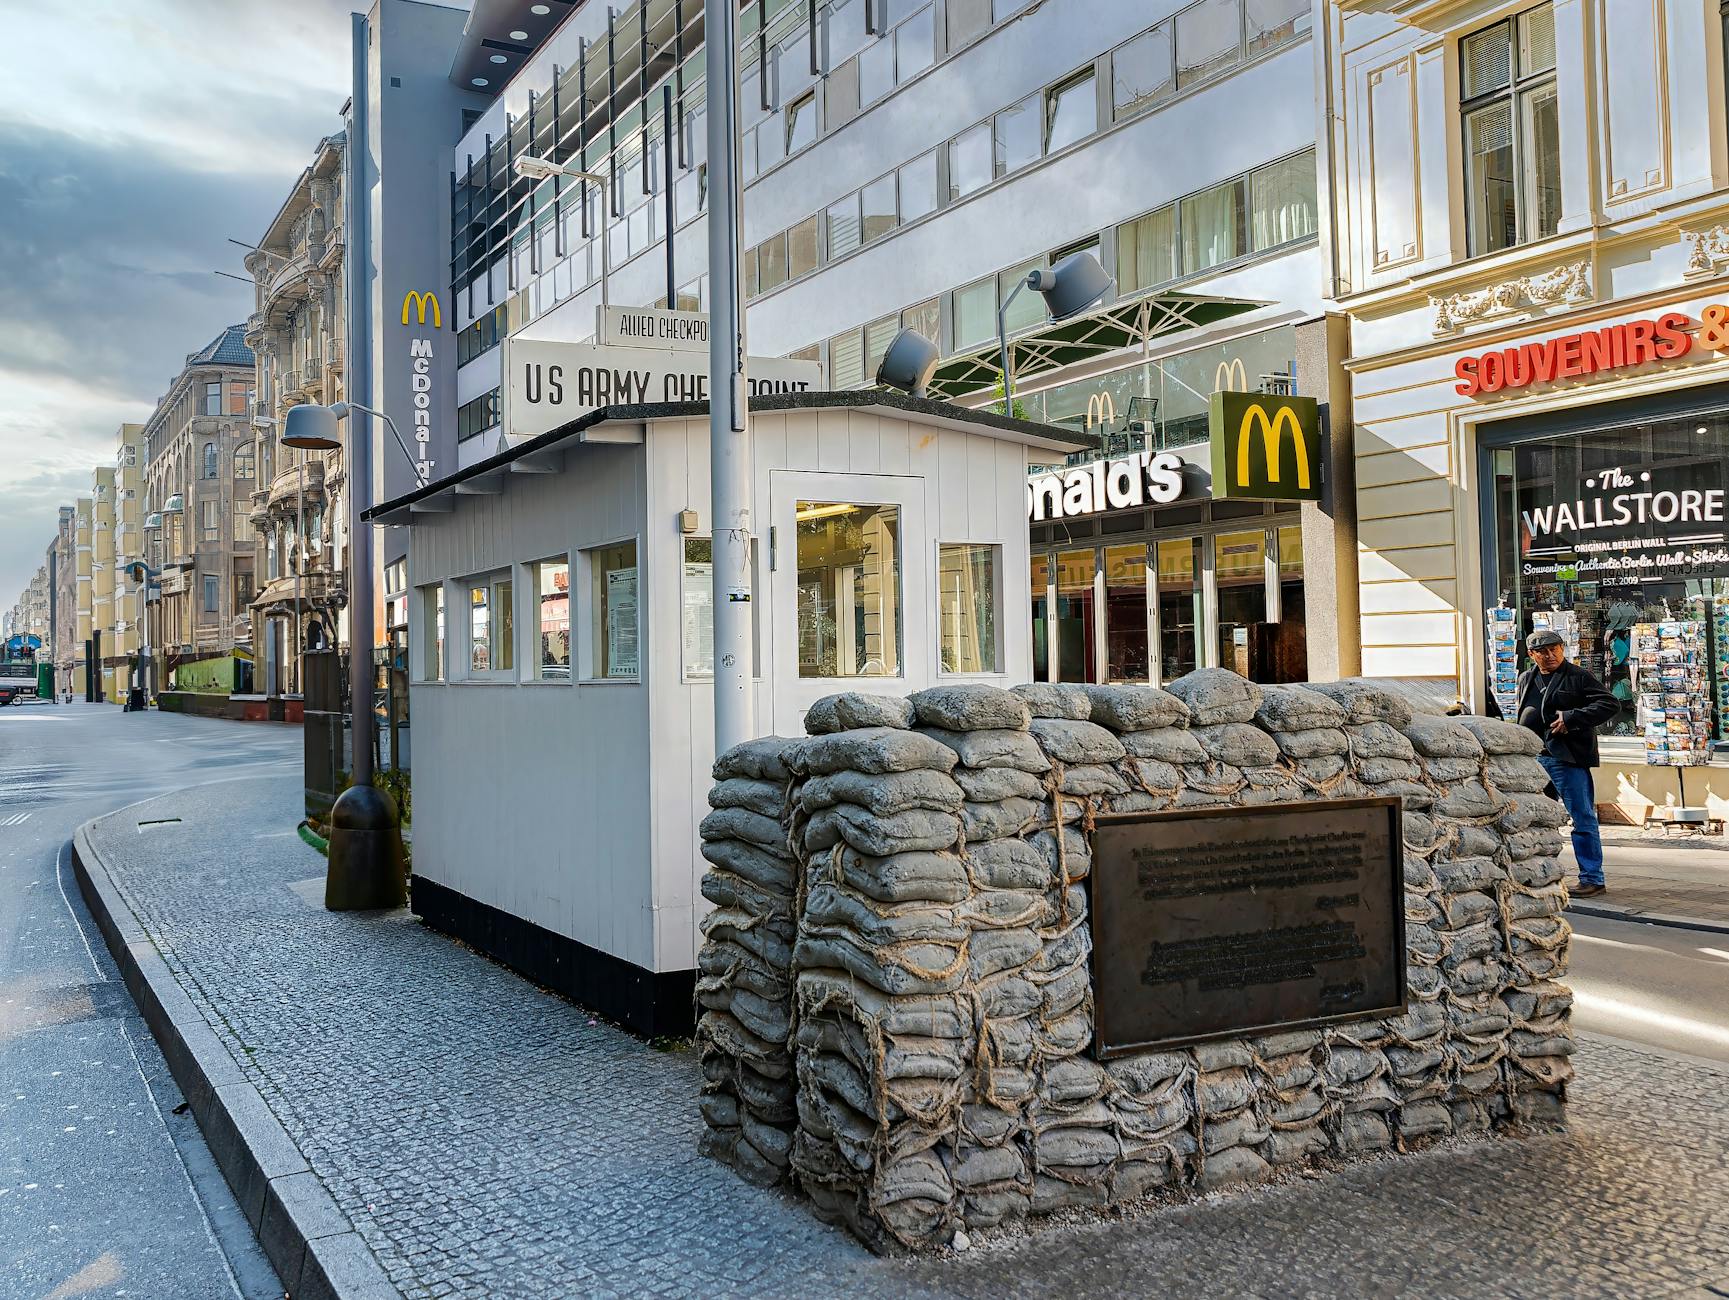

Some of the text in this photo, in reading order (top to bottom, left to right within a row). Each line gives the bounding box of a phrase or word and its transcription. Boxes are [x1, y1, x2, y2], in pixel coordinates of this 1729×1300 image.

[620, 314, 710, 342] ALLIED CHECKPO
[1455, 313, 1692, 396] SOUVENIRS
[525, 363, 563, 405] US
[578, 367, 651, 407] ARMY
[1028, 452, 1183, 521] nald's
[1599, 467, 1634, 490] The
[1522, 490, 1725, 538] WALLSTORE
[1574, 537, 1666, 553] ORIGINAL BERLIN WALL
[1523, 563, 1567, 575] Souvenirs
[1575, 556, 1621, 572] Authentic
[1621, 553, 1654, 569] Berlin
[1656, 551, 1685, 567] Wall
[1692, 549, 1729, 565] Shirts
[1603, 575, 1639, 586] EST. 2009
